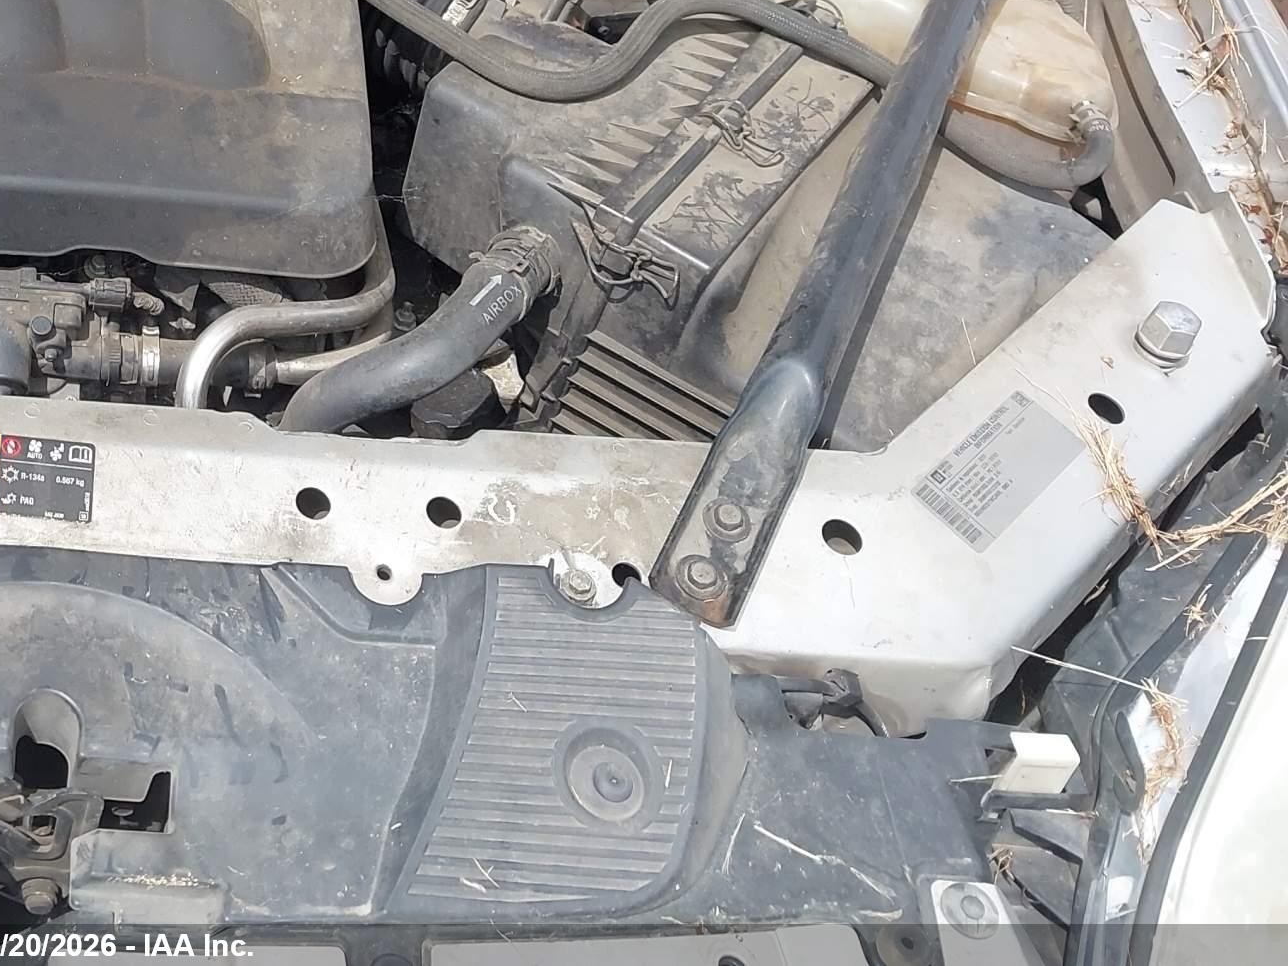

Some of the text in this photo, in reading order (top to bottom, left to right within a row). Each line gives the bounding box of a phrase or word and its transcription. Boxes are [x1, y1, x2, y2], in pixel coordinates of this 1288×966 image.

[481, 284, 523, 325] AIRBOX
[21, 472, 45, 482] R-134a
[76, 477, 84, 487] kg
